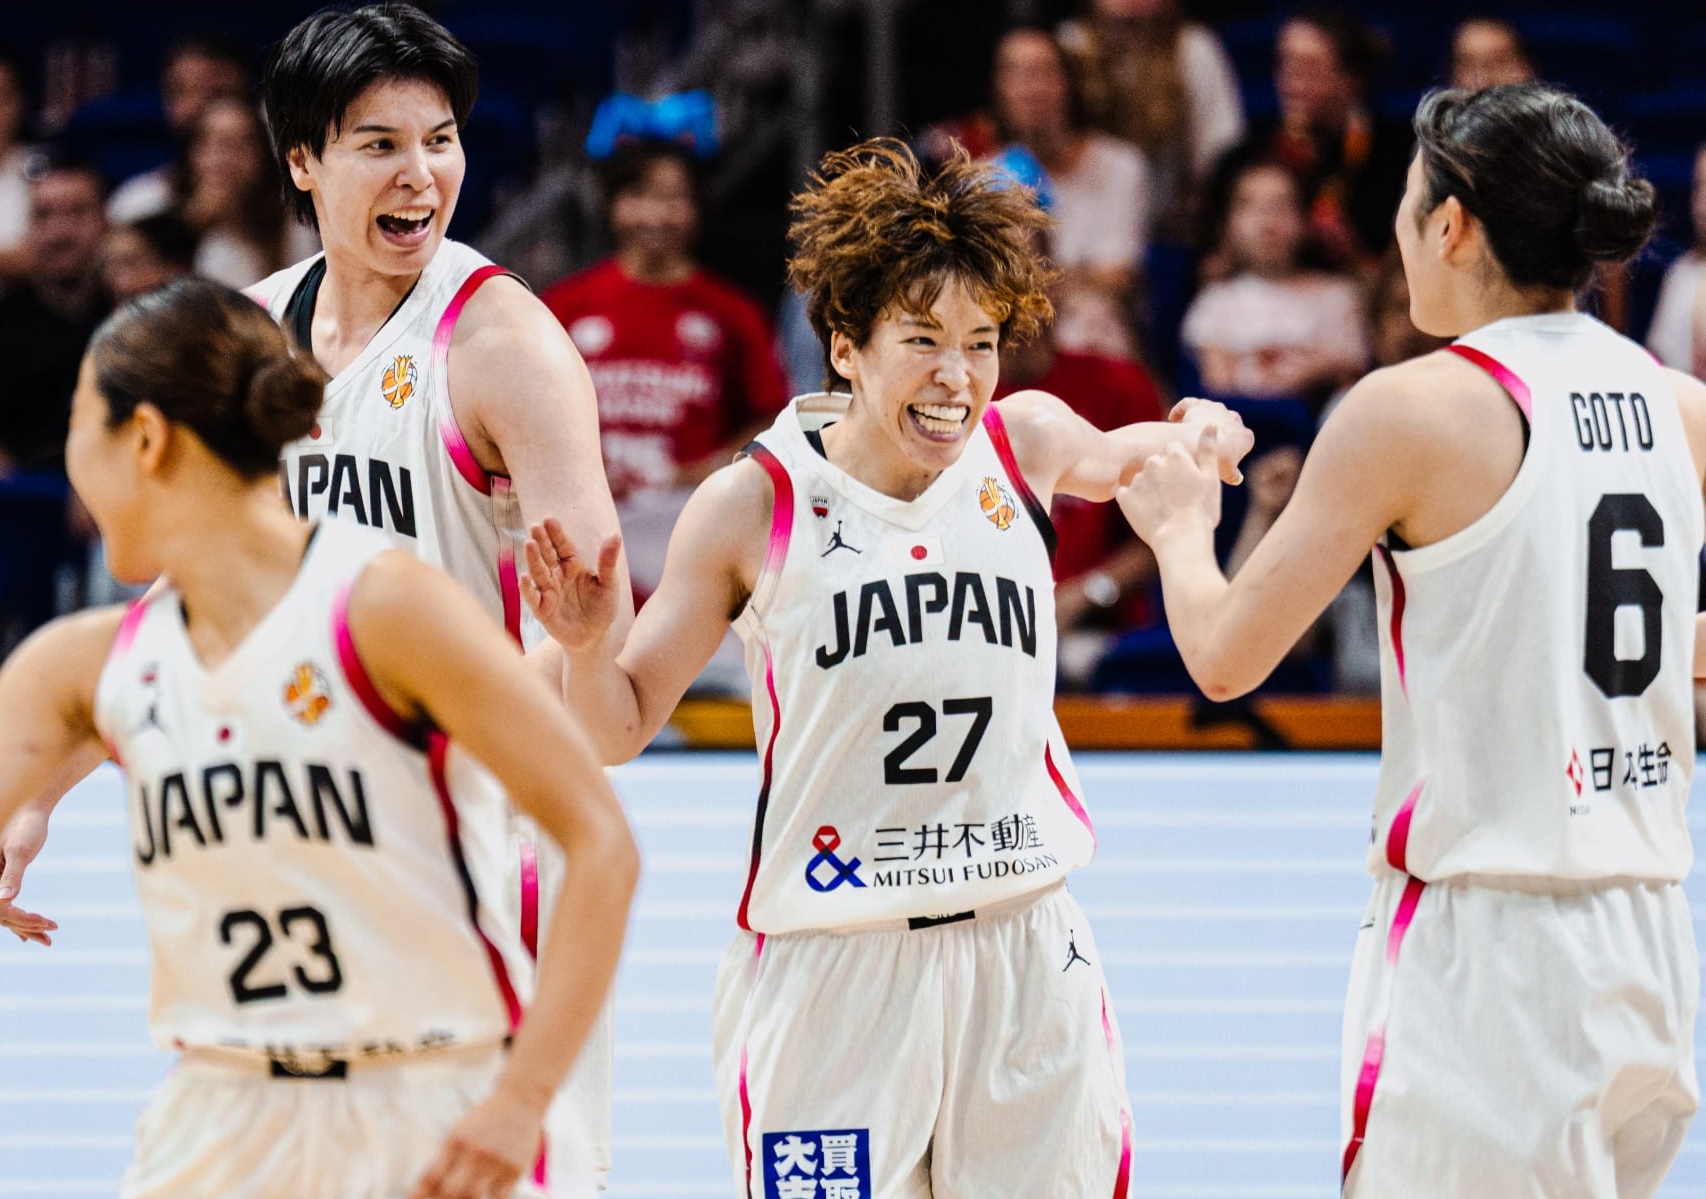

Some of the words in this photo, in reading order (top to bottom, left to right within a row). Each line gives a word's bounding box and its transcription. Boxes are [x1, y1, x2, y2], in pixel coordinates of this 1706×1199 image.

[1570, 391, 1653, 452] GOTO
[815, 571, 1037, 670] JAPAN
[1583, 493, 1665, 699] 6
[883, 696, 993, 785] 27
[136, 761, 374, 866] JAPAN
[874, 813, 1044, 862] 三井不動産
[874, 867, 954, 888] MITSUI
[964, 853, 1058, 881] FUDOSAN
[220, 906, 342, 1004] 23
